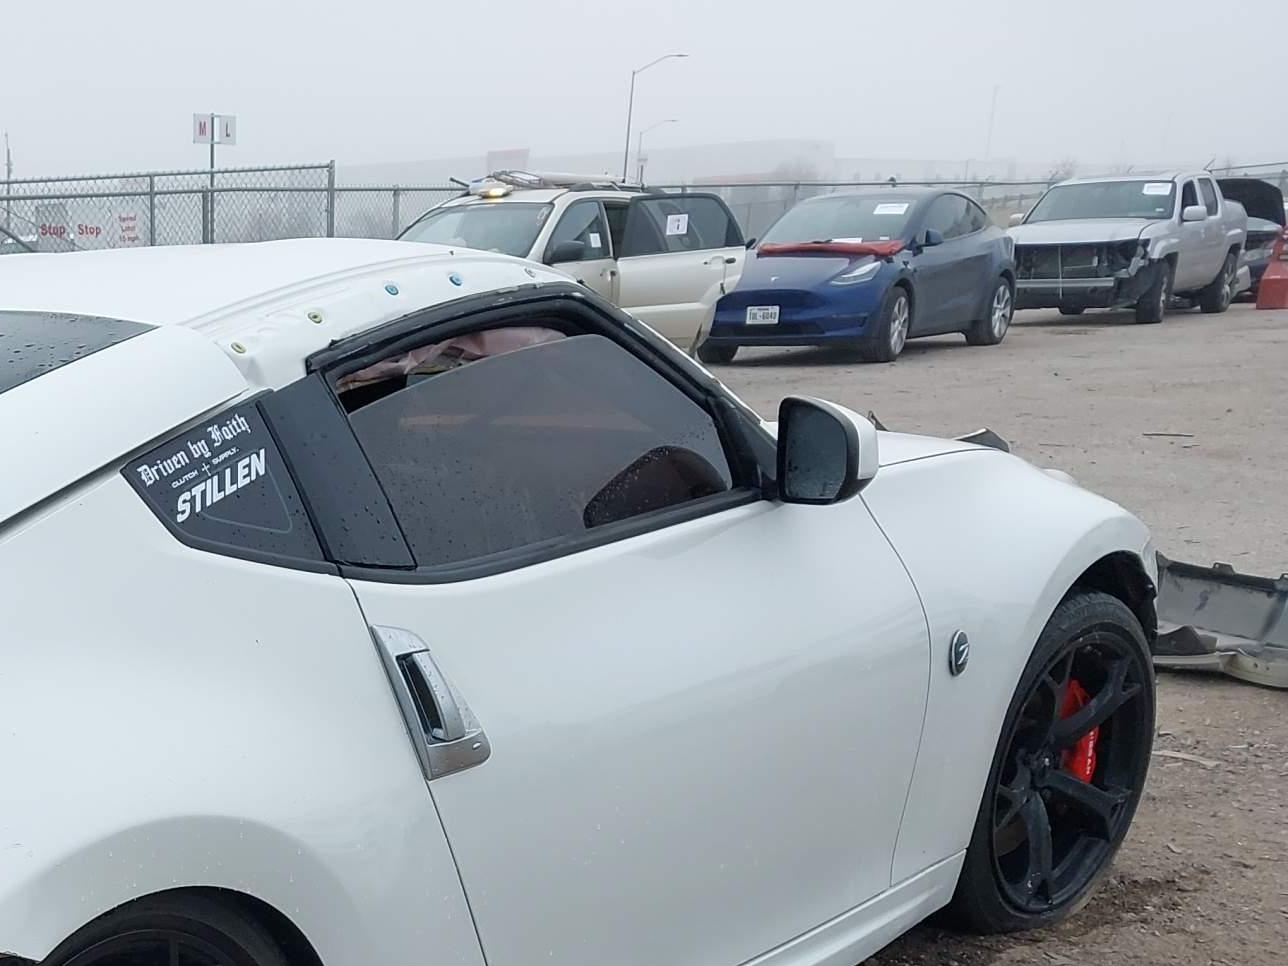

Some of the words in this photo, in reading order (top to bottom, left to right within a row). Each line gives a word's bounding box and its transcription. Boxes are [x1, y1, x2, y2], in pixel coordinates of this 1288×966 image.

[198, 120, 207, 137] M
[225, 122, 231, 138] L
[40, 223, 66, 239] Stop
[77, 223, 102, 238] Stop
[136, 450, 190, 488] Driven
[187, 439, 213, 459] by
[206, 413, 252, 449] Faith
[171, 469, 199, 489] CLUTCH
[176, 447, 266, 524] STILLEN
